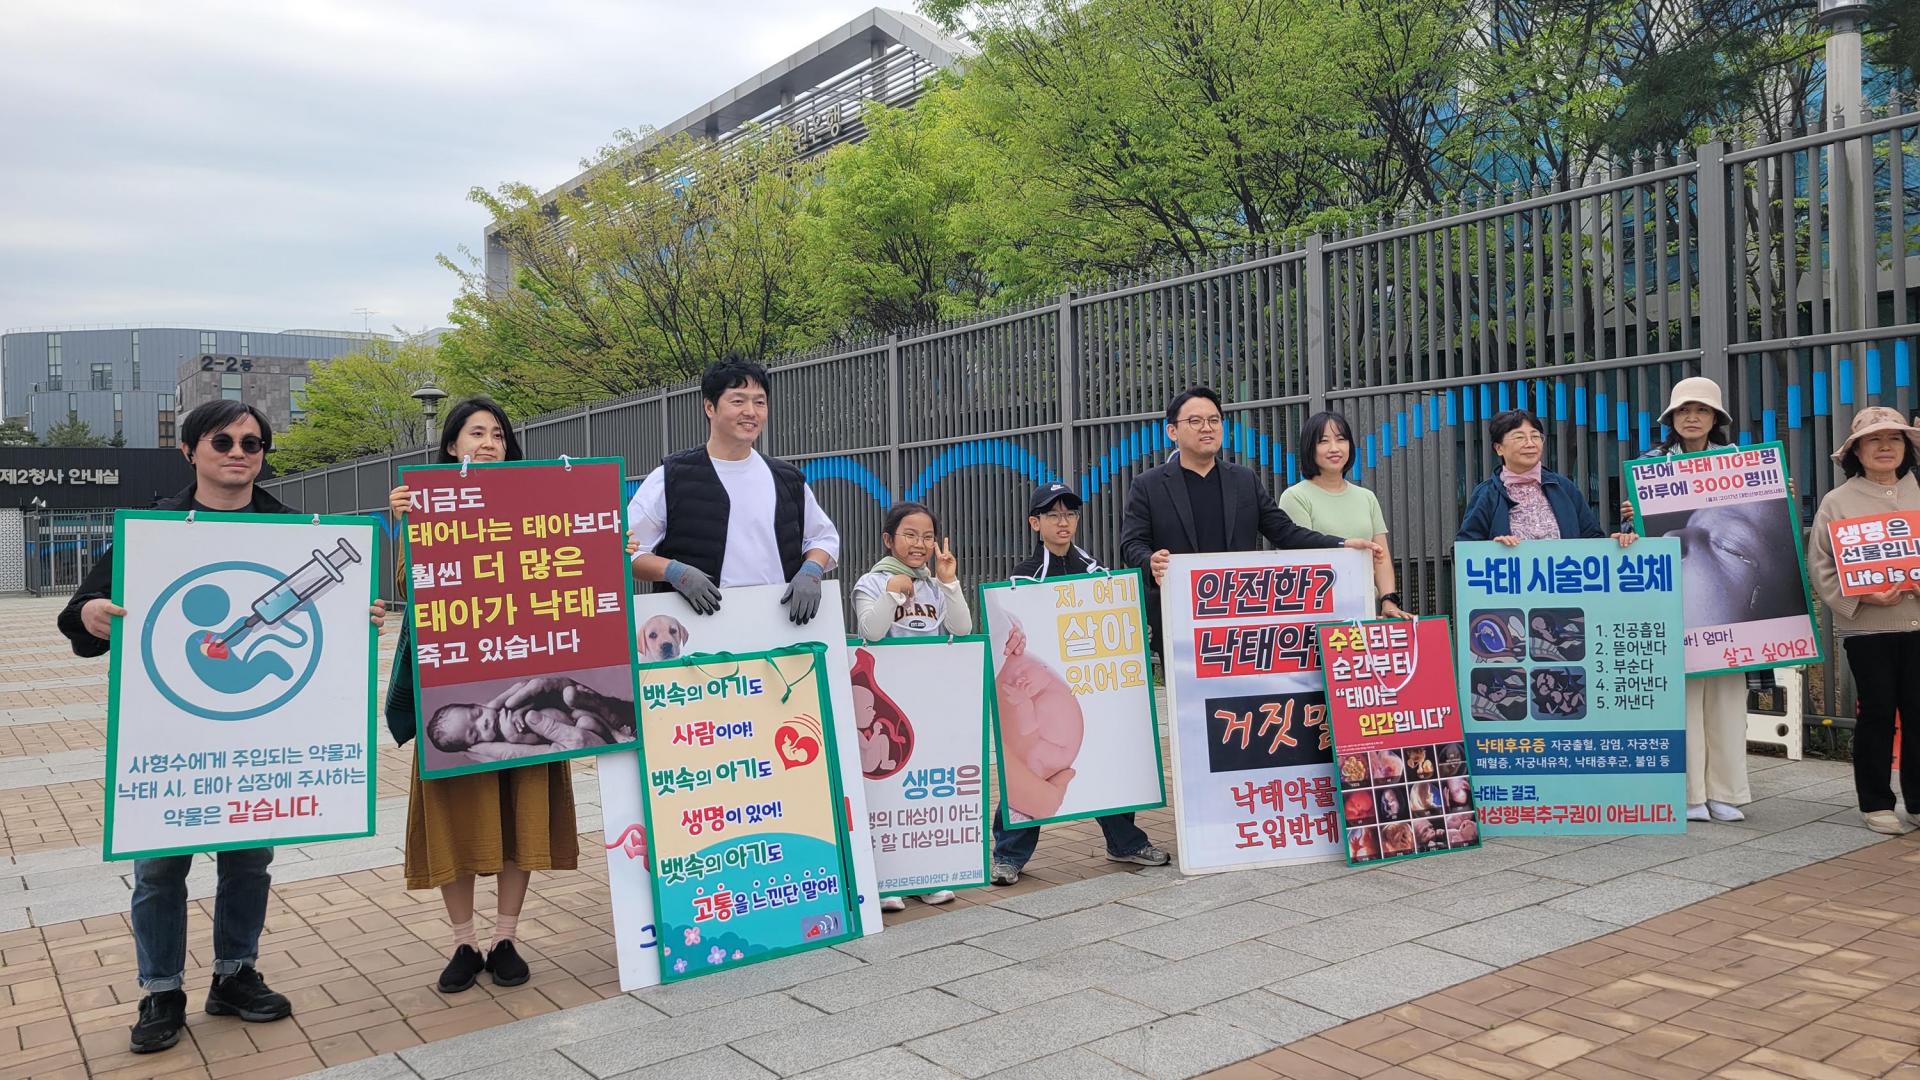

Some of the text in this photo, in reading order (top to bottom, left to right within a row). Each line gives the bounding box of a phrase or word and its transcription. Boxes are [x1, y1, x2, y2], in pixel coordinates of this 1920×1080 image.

[201, 355, 253, 372] 2-2동
[0, 468, 119, 485] 제2청사 안내실
[1632, 448, 1776, 481] 1년에 낙태 110만명
[409, 487, 485, 513] 지금도
[1638, 469, 1778, 500] 하루에 3000명!!!
[408, 510, 621, 546] 태어나는 태아보다
[1836, 518, 1911, 544] 생명은
[412, 546, 585, 589] 훨씬 더 많은
[1466, 554, 1672, 594] 낙태 시술의 실체
[1846, 569, 1884, 587] Life
[1887, 567, 1905, 582] is
[1054, 575, 1136, 609] 저, 여기
[1197, 567, 1336, 617] 안전한?
[415, 587, 620, 632] 태아가 낙태로
[1063, 612, 1137, 657] 살아
[1329, 625, 1408, 653] 수정되는
[1596, 622, 1665, 638] 1. 진공흡입
[1703, 628, 1733, 646] 엄마!
[417, 629, 580, 668] 죽고 있습니다
[1201, 624, 1321, 674] 낙태약
[1595, 643, 1608, 655] 2.
[1723, 636, 1817, 667] 살고 싶어요!
[1066, 660, 1145, 696] 있어요
[1333, 651, 1411, 680] 순간부터
[1596, 658, 1653, 674] 3. 부순다
[643, 675, 763, 710] 뱃속의 아기도
[1596, 676, 1667, 692] 4. 긁어낸다
[1597, 694, 1654, 710] 5. 꺼낸다
[672, 721, 753, 746] 사람이야!
[1476, 738, 1670, 753] 낙태후유증 자궁출혈, 감염, 자궁천공
[129, 743, 363, 774] 사형수에게 주입되는 약물과
[1476, 756, 1670, 769] 패혈증, 자궁내유착, 낙태증후군, 불임 등
[119, 767, 366, 800] 낙태 시, 태아 심장에 주사하는
[652, 758, 772, 796] 뱃속의 아기도
[902, 765, 981, 800] 생명은
[1231, 776, 1338, 815] 낙태약물
[1474, 785, 1539, 801] 낙태는 결코,
[164, 795, 323, 827] 약물은 같습니다.
[681, 801, 783, 836] 생명이 있어!
[898, 806, 944, 826] 대상이
[949, 803, 982, 821] 아닌,
[1477, 804, 1677, 825] 여성행복추구권이 아닙니다.
[881, 833, 897, 852] 할
[902, 826, 983, 848] 대상입니다.
[1235, 810, 1339, 849] 도입반대
[661, 841, 782, 885] 뱃속의 아기도
[693, 875, 838, 922] 고통을 느낀단 말야!
